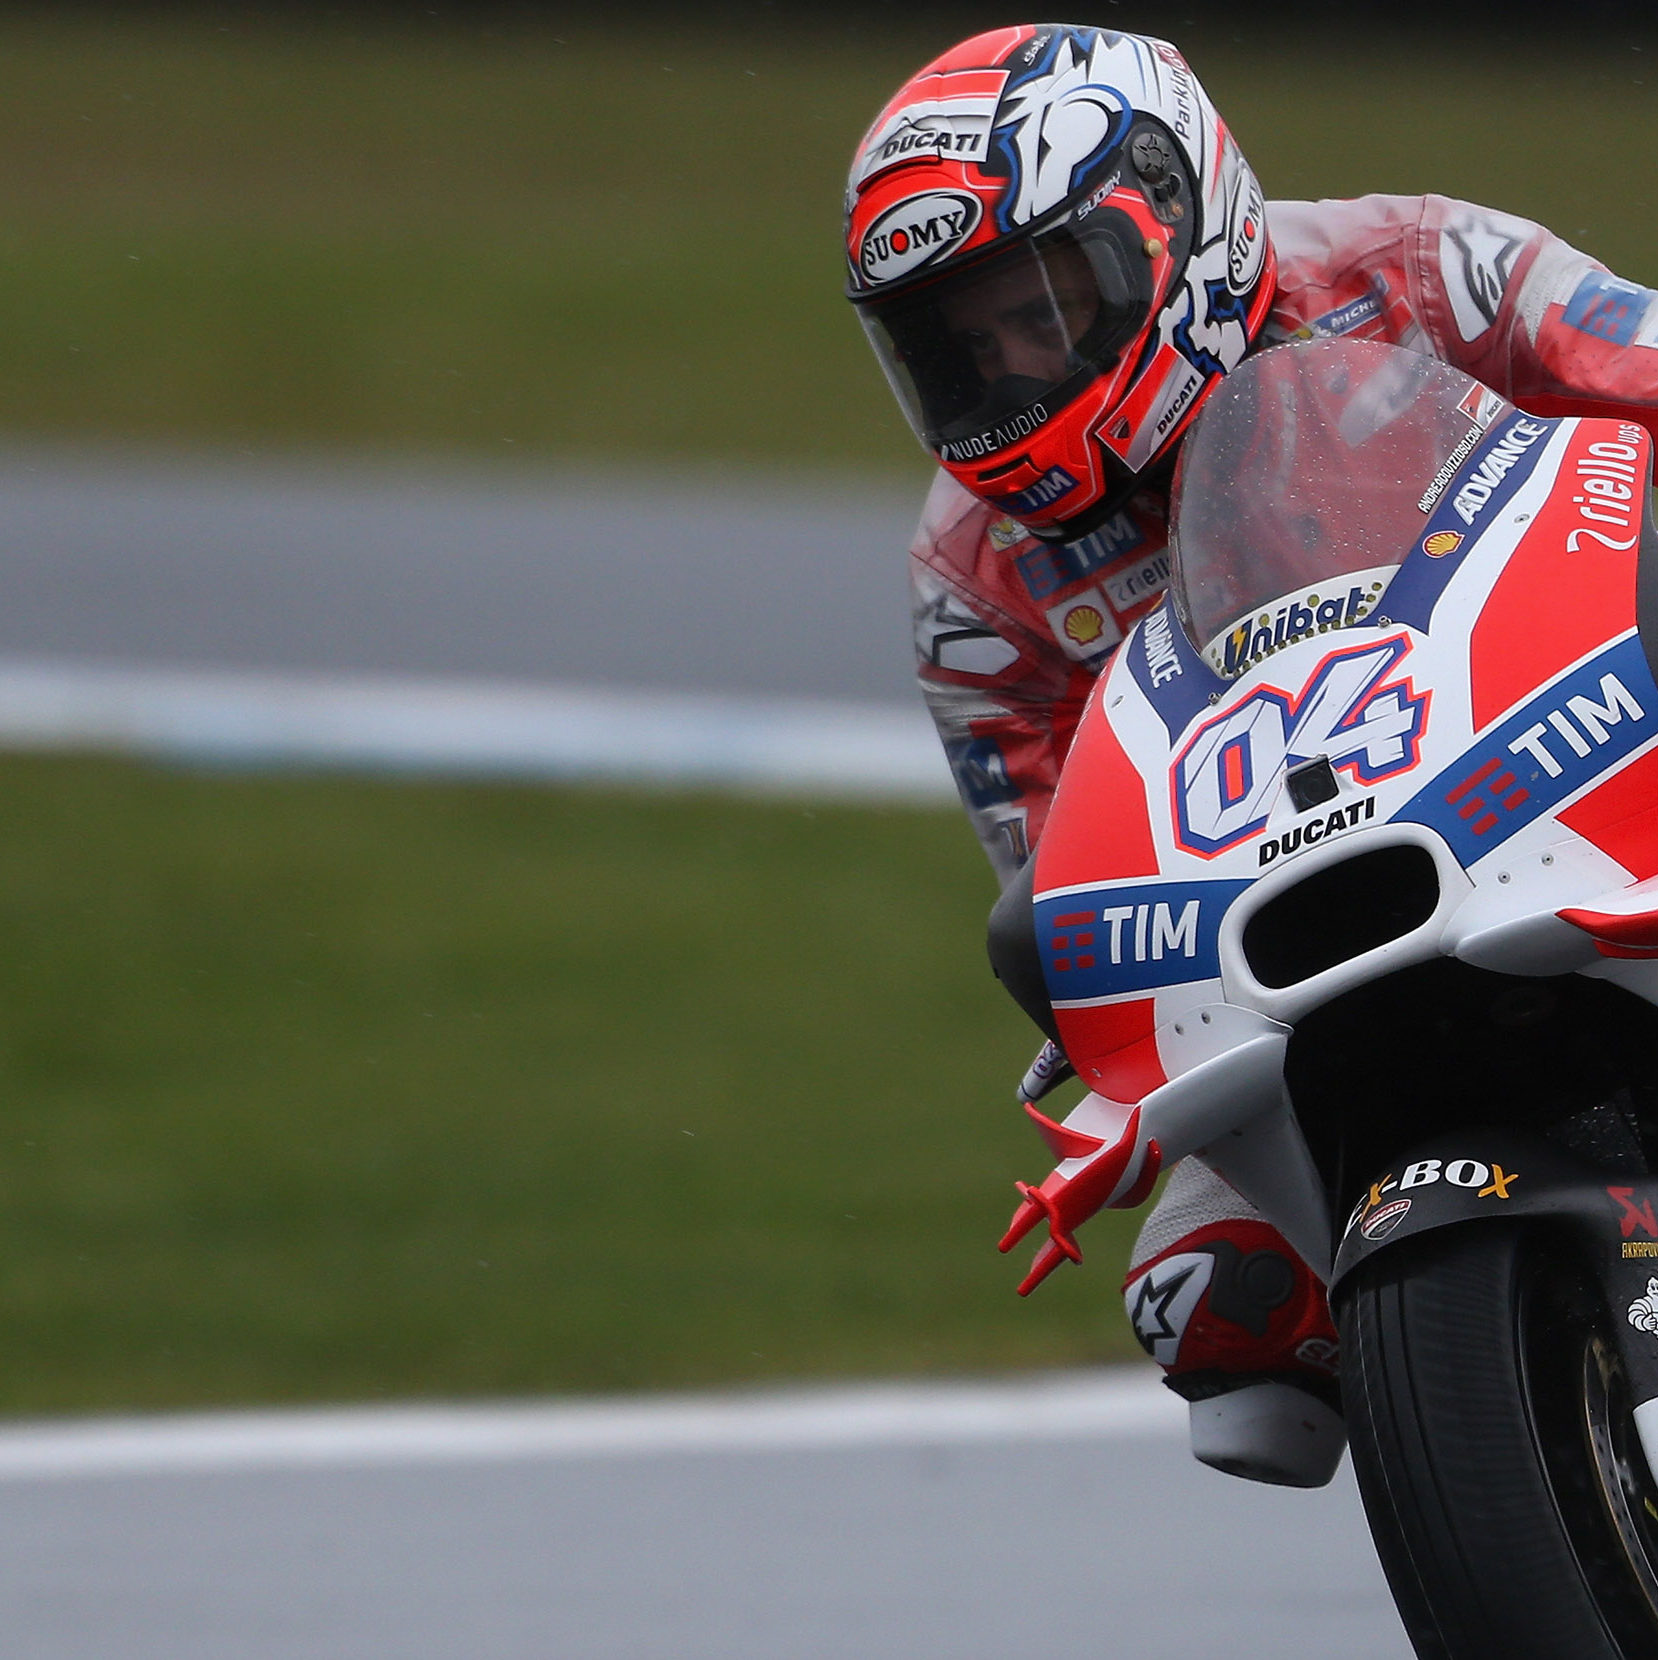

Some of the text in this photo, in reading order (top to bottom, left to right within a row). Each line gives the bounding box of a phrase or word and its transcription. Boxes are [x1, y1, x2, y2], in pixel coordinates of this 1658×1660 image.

[882, 131, 982, 161] DUCATI
[1077, 171, 1121, 221] SUOMY
[866, 211, 964, 266] SUOMY
[1157, 375, 1199, 435] DUCATI
[1022, 471, 1072, 508] TIM
[1453, 418, 1549, 526] ADVANCE
[1572, 424, 1643, 527] riello ups
[1063, 512, 1137, 569] TIM
[1222, 586, 1366, 674] Unibat
[1169, 631, 1434, 861] 04
[1508, 672, 1647, 779] TIM
[1259, 795, 1376, 868] DUCATI
[1102, 900, 1201, 965] TIM
